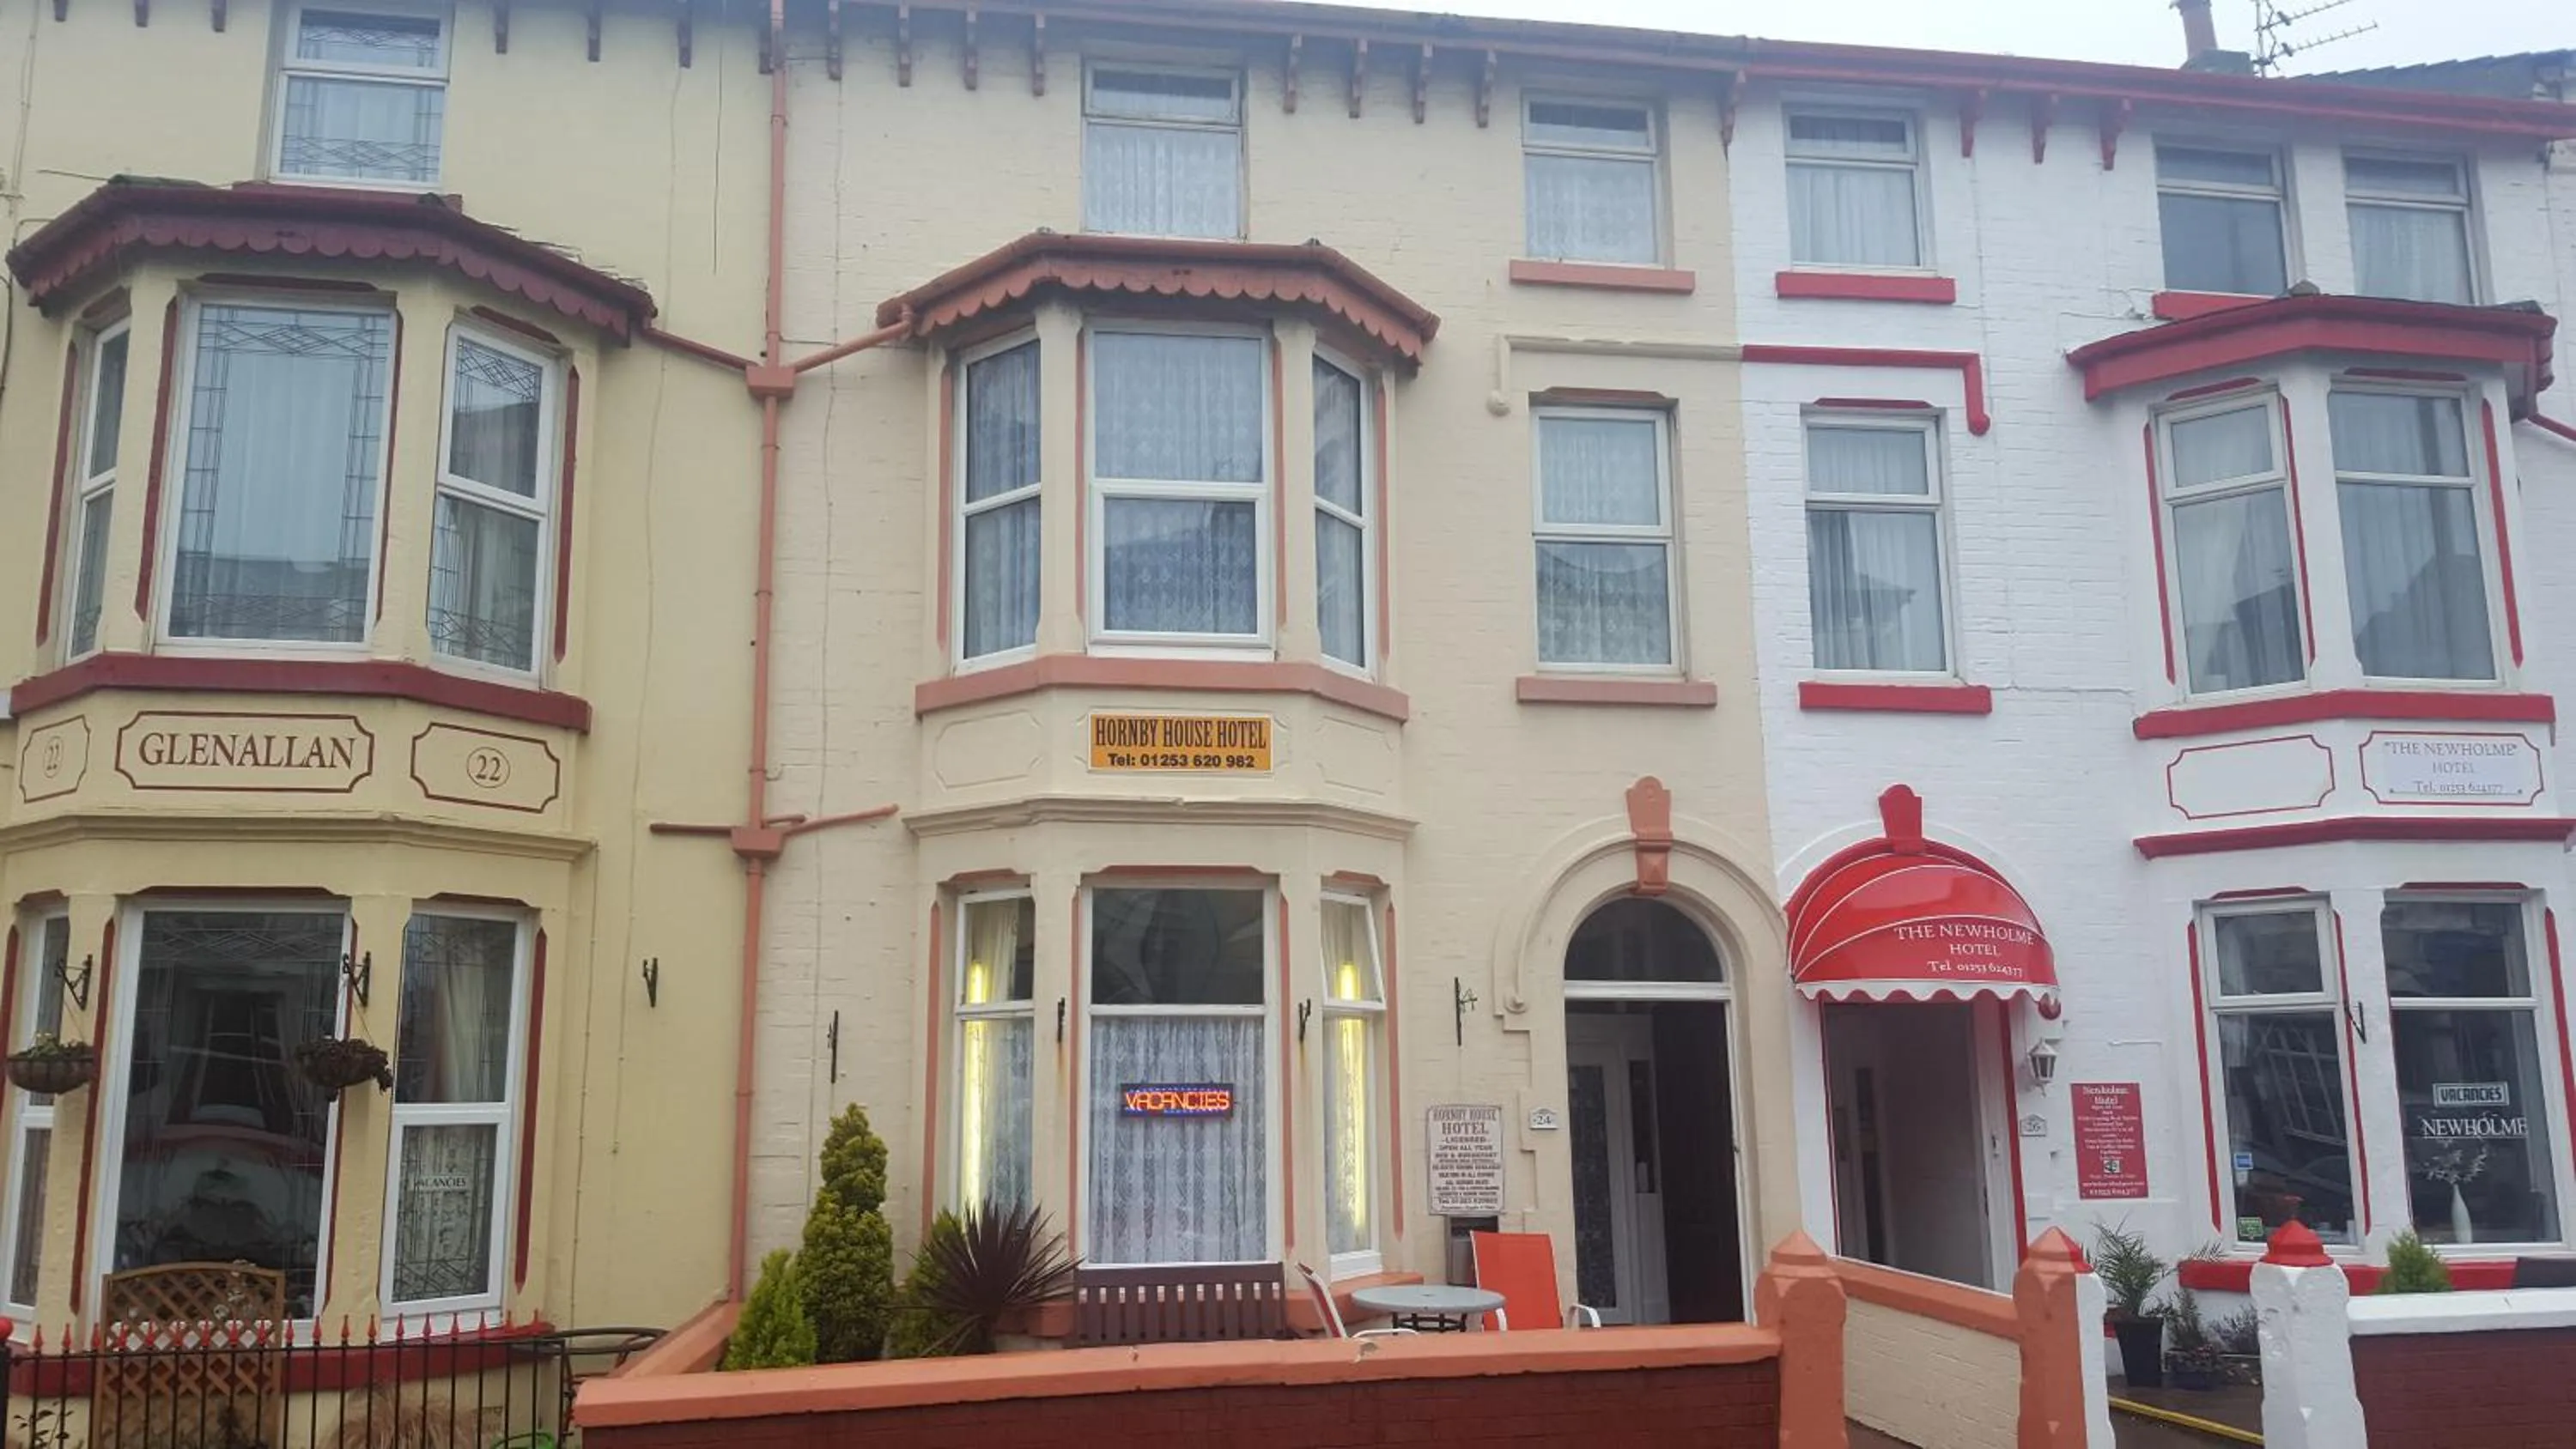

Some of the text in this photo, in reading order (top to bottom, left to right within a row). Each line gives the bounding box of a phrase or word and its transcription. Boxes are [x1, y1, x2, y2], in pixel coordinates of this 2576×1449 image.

[1095, 718, 1267, 749] HORNBY HOUSE HOTEL
[138, 731, 355, 771] GLENALLAN
[475, 755, 501, 781] 22
[1108, 753, 1255, 768] Tel: 01253 620 982
[1893, 924, 2035, 945] THE NEWHOLME
[1949, 943, 2002, 956] HOTEL
[1927, 960, 1952, 973] Tel
[1125, 1089, 1230, 1111] VACANCIES
[2440, 1088, 2502, 1101] VACANCIES
[1442, 1121, 1489, 1135] HOTEL
[2421, 1117, 2529, 1136] NEWHOLME
[415, 1178, 466, 1187] ACANCIES
